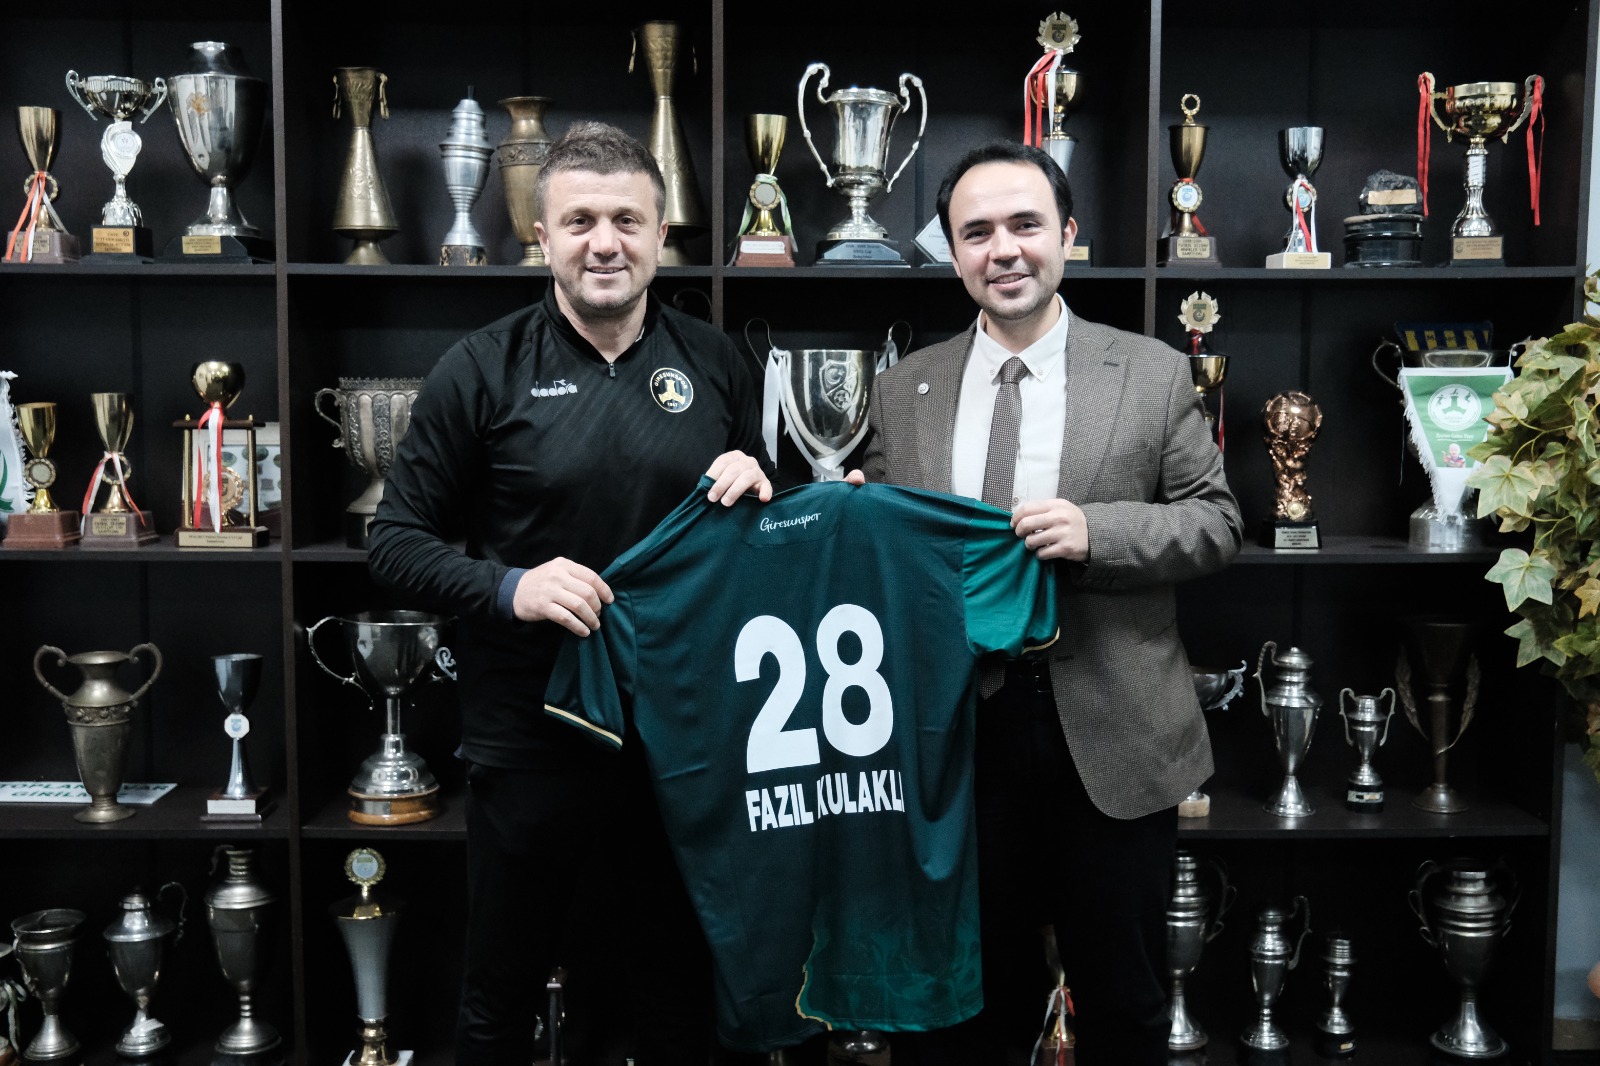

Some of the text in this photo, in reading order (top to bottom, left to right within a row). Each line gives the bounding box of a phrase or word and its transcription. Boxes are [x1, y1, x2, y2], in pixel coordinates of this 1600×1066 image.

[530, 379, 578, 397] diadora
[759, 512, 822, 533] Giresunspor
[734, 603, 894, 774] 28
[745, 769, 906, 832] FAZIL KULAKLI
